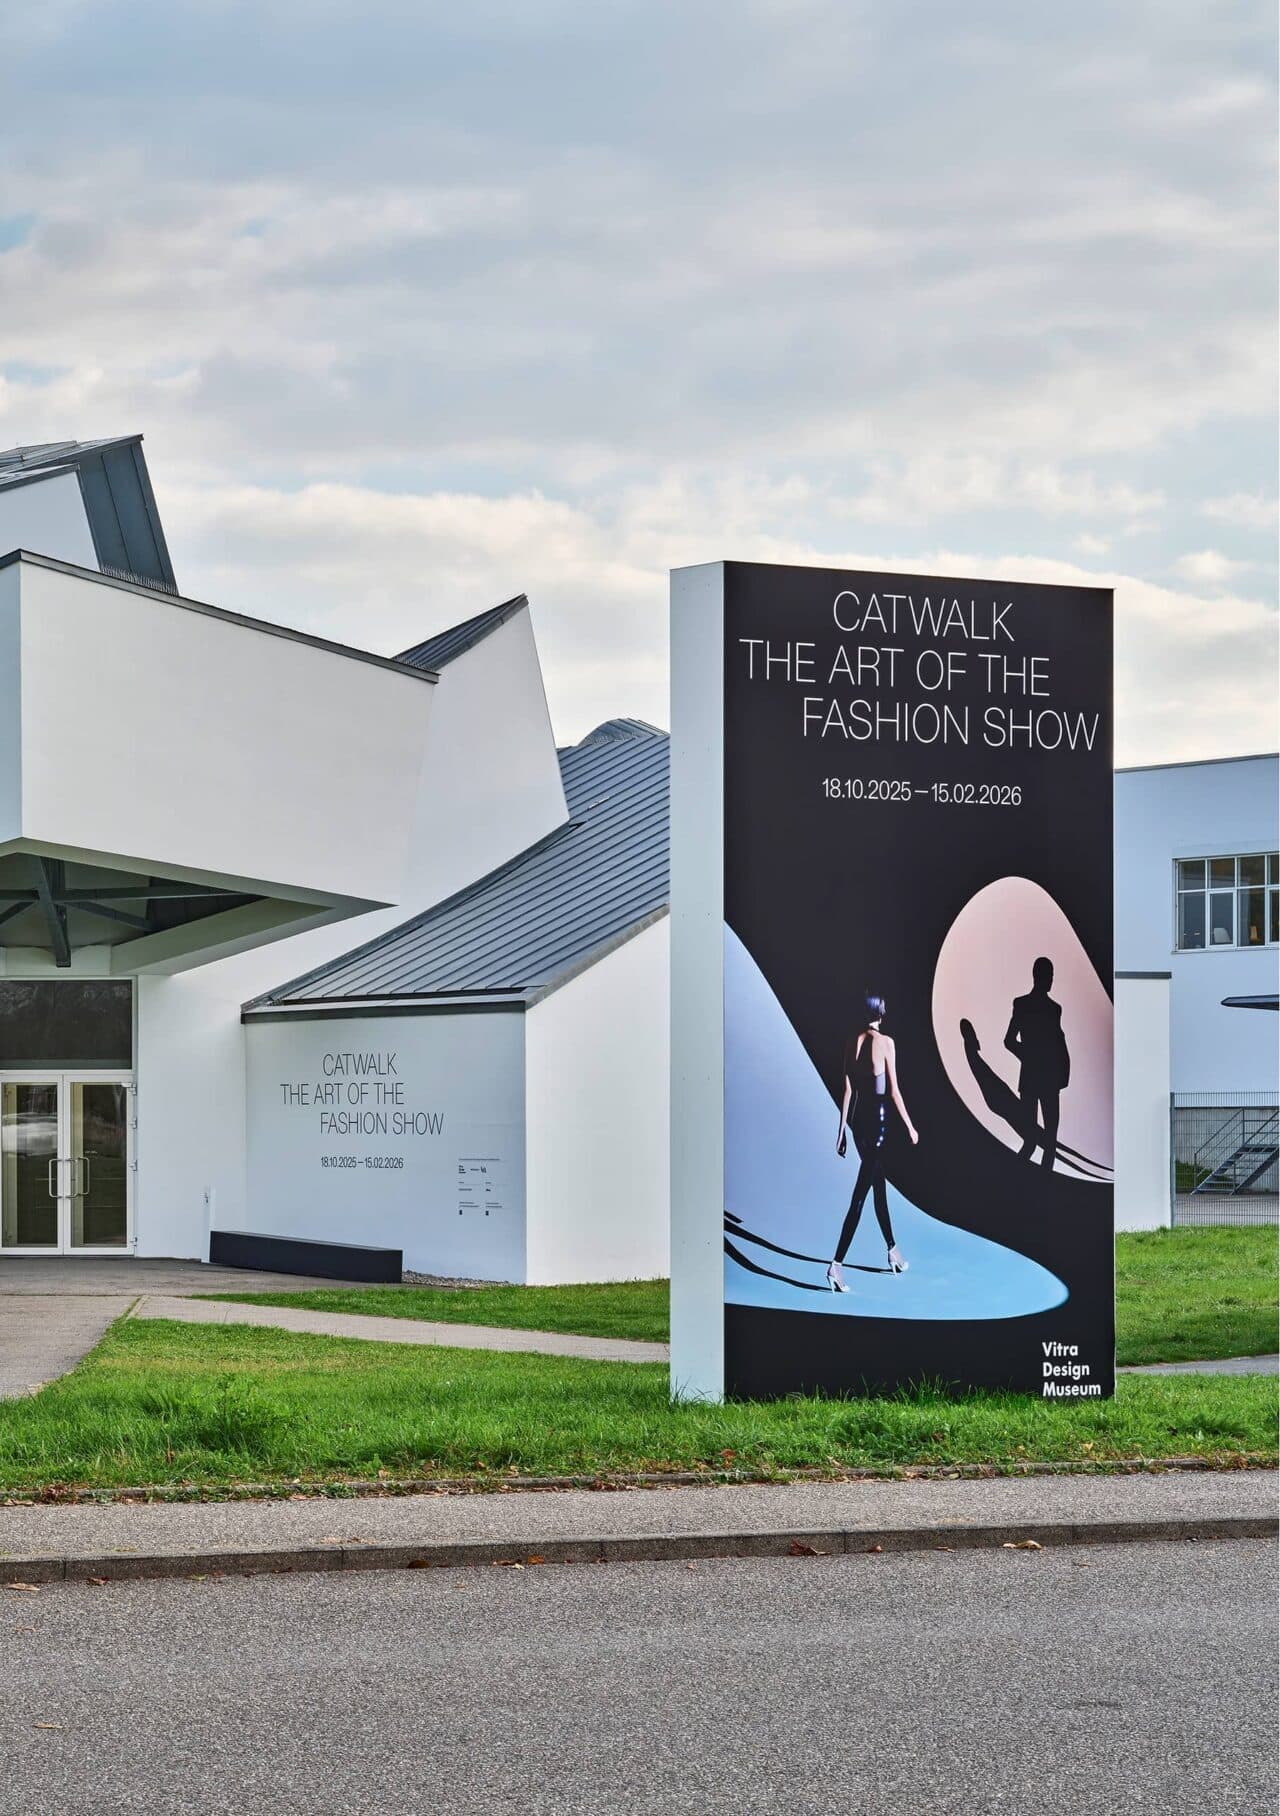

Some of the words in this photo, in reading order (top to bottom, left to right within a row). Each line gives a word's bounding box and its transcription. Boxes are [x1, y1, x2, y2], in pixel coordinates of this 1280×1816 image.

[833, 590, 1015, 642] CATWALK
[738, 638, 817, 683] THE
[828, 644, 905, 688] ART
[916, 649, 968, 691] OF
[977, 653, 1051, 697] THE
[803, 696, 969, 745] FASHION
[983, 706, 1100, 752] SHOW
[322, 1053, 397, 1076] CATWALK
[279, 1083, 310, 1105] THE
[313, 1082, 344, 1105] ART
[347, 1082, 369, 1105] OF
[373, 1082, 405, 1105] THE
[320, 1111, 388, 1135] FASHION
[392, 1112, 444, 1136] SHOW
[1042, 1341, 1079, 1357] Vitra
[1042, 1360, 1090, 1381] Design
[1042, 1381, 1102, 1397] Museum
